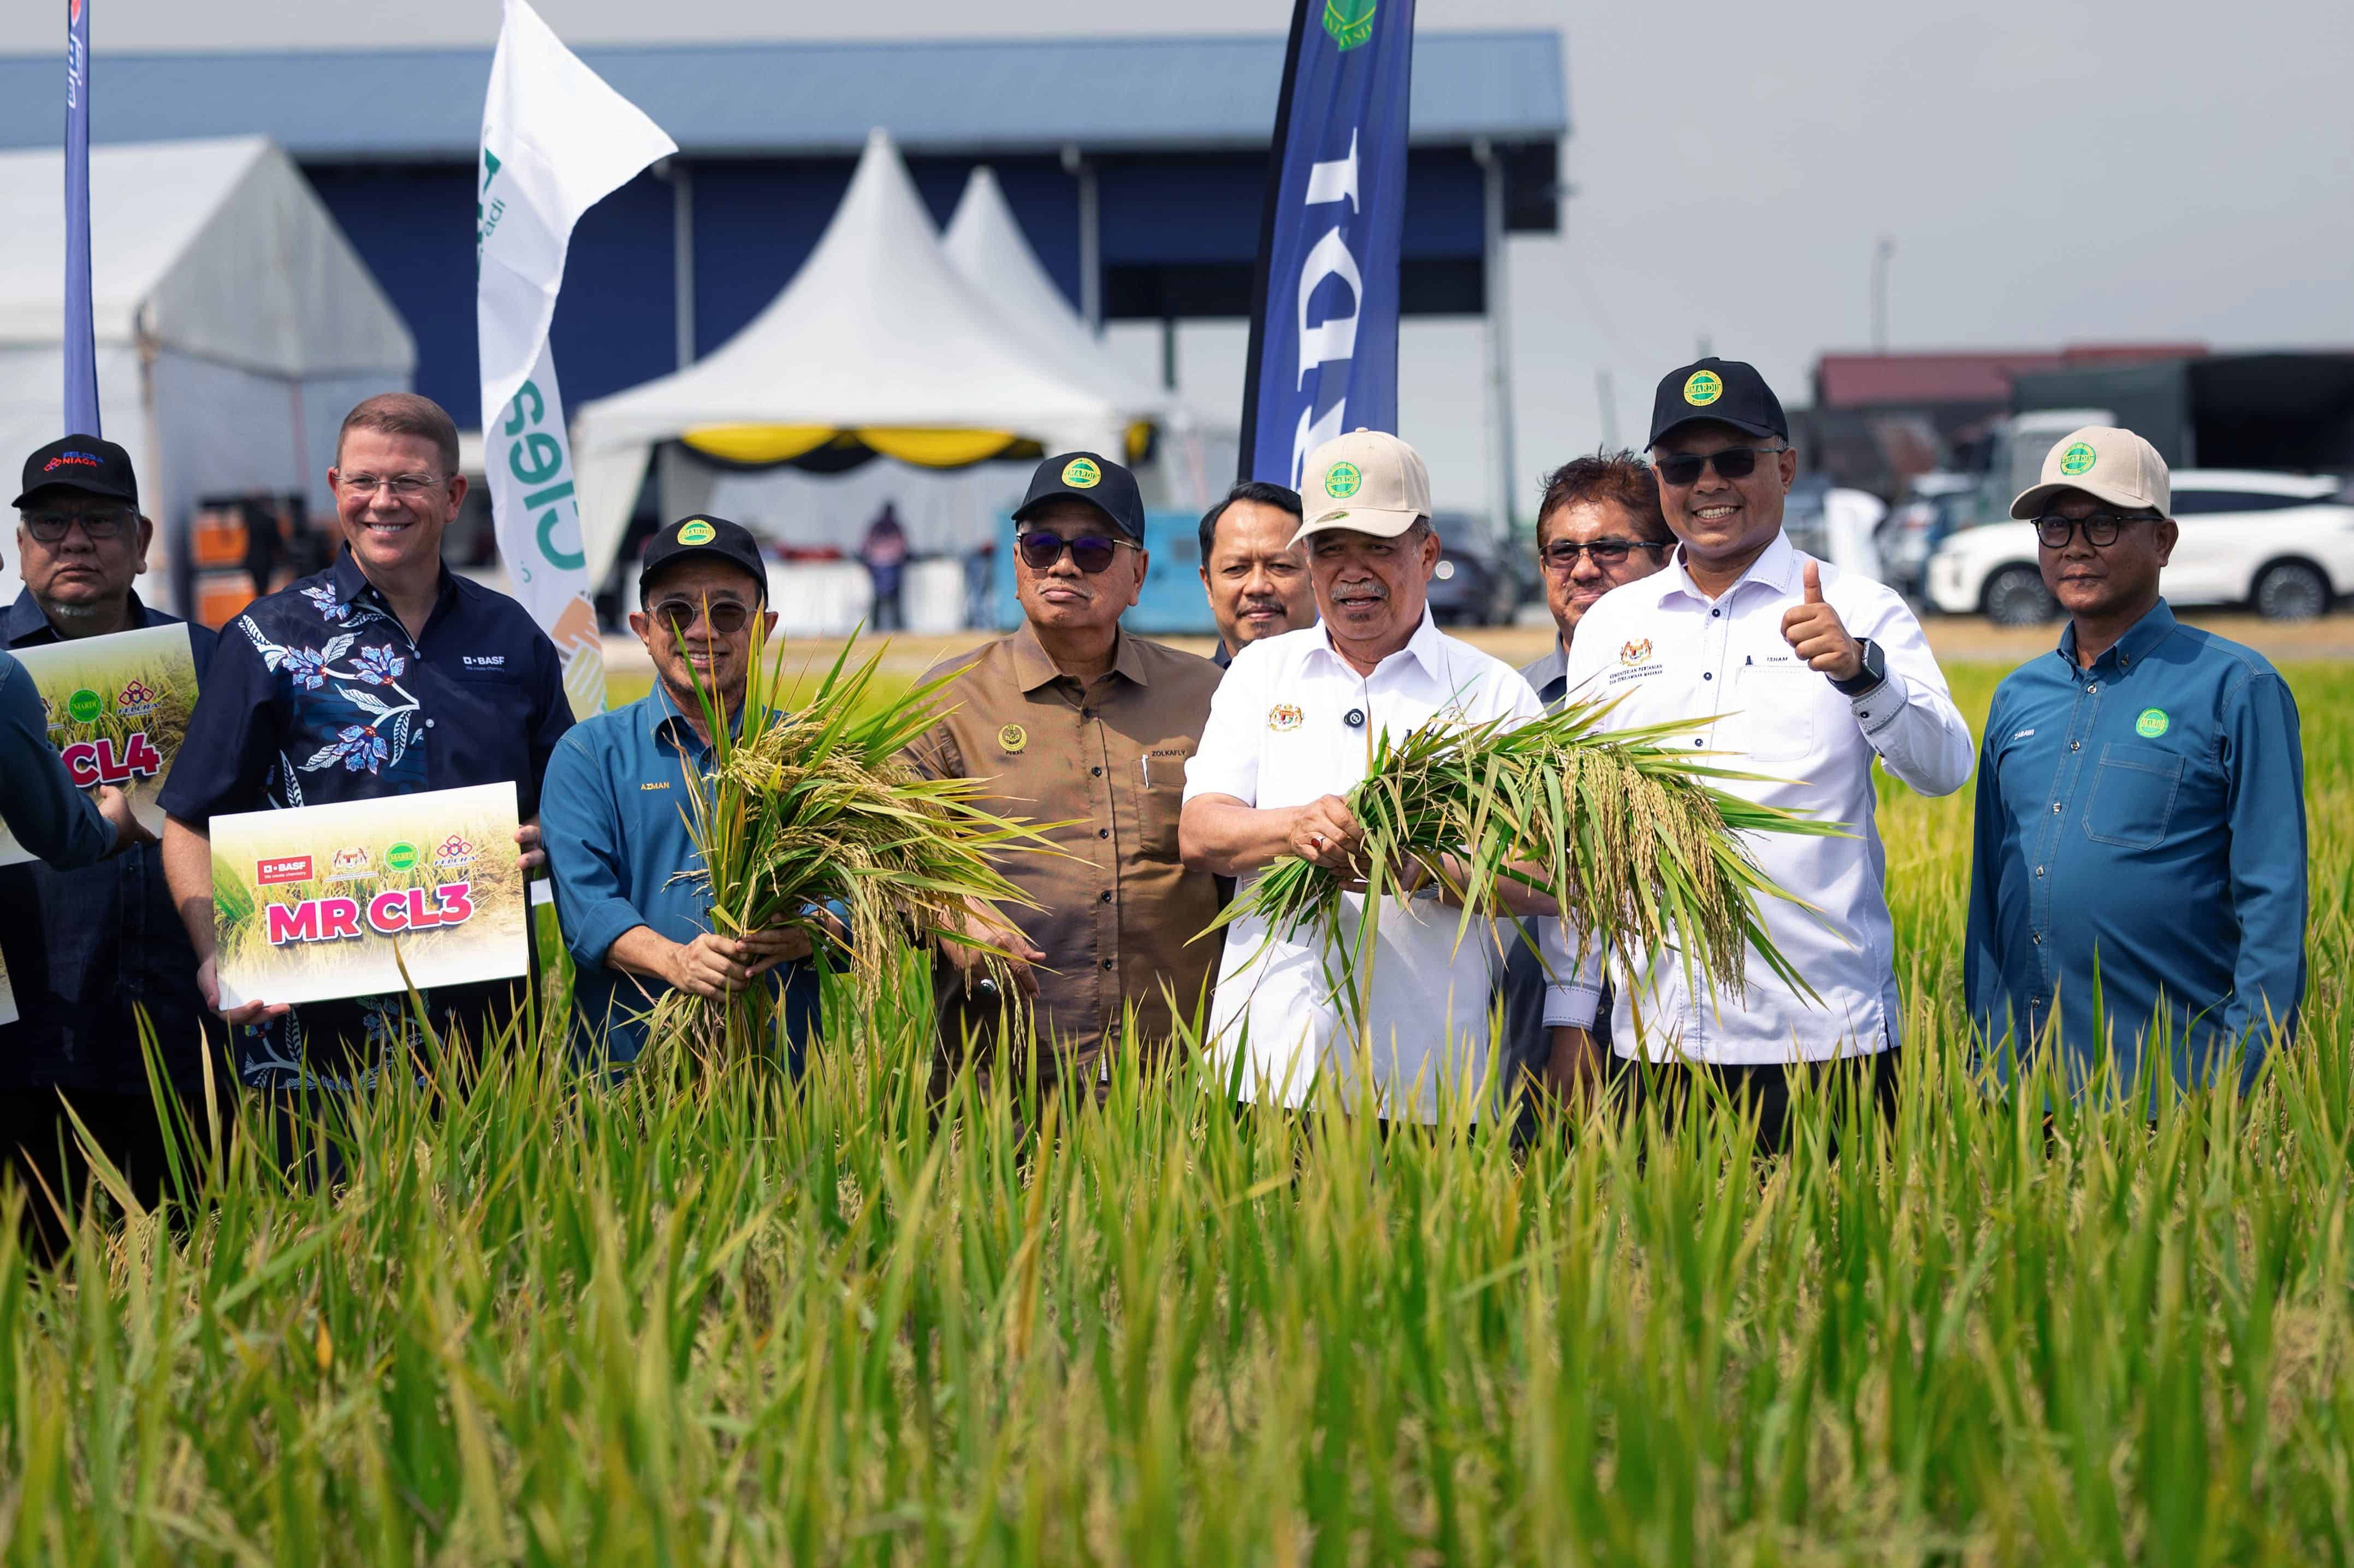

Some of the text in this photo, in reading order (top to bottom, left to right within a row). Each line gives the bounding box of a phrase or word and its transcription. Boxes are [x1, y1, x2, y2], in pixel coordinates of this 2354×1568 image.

[1689, 384, 1716, 394] MARDI
[63, 458, 97, 467] NIAGA
[1068, 469, 1094, 479] MARDI
[477, 656, 505, 664] BASF
[61, 733, 162, 787] CL4
[641, 782, 669, 790] AZMAN
[278, 862, 306, 872] BASF
[268, 883, 474, 944] MR CL3
